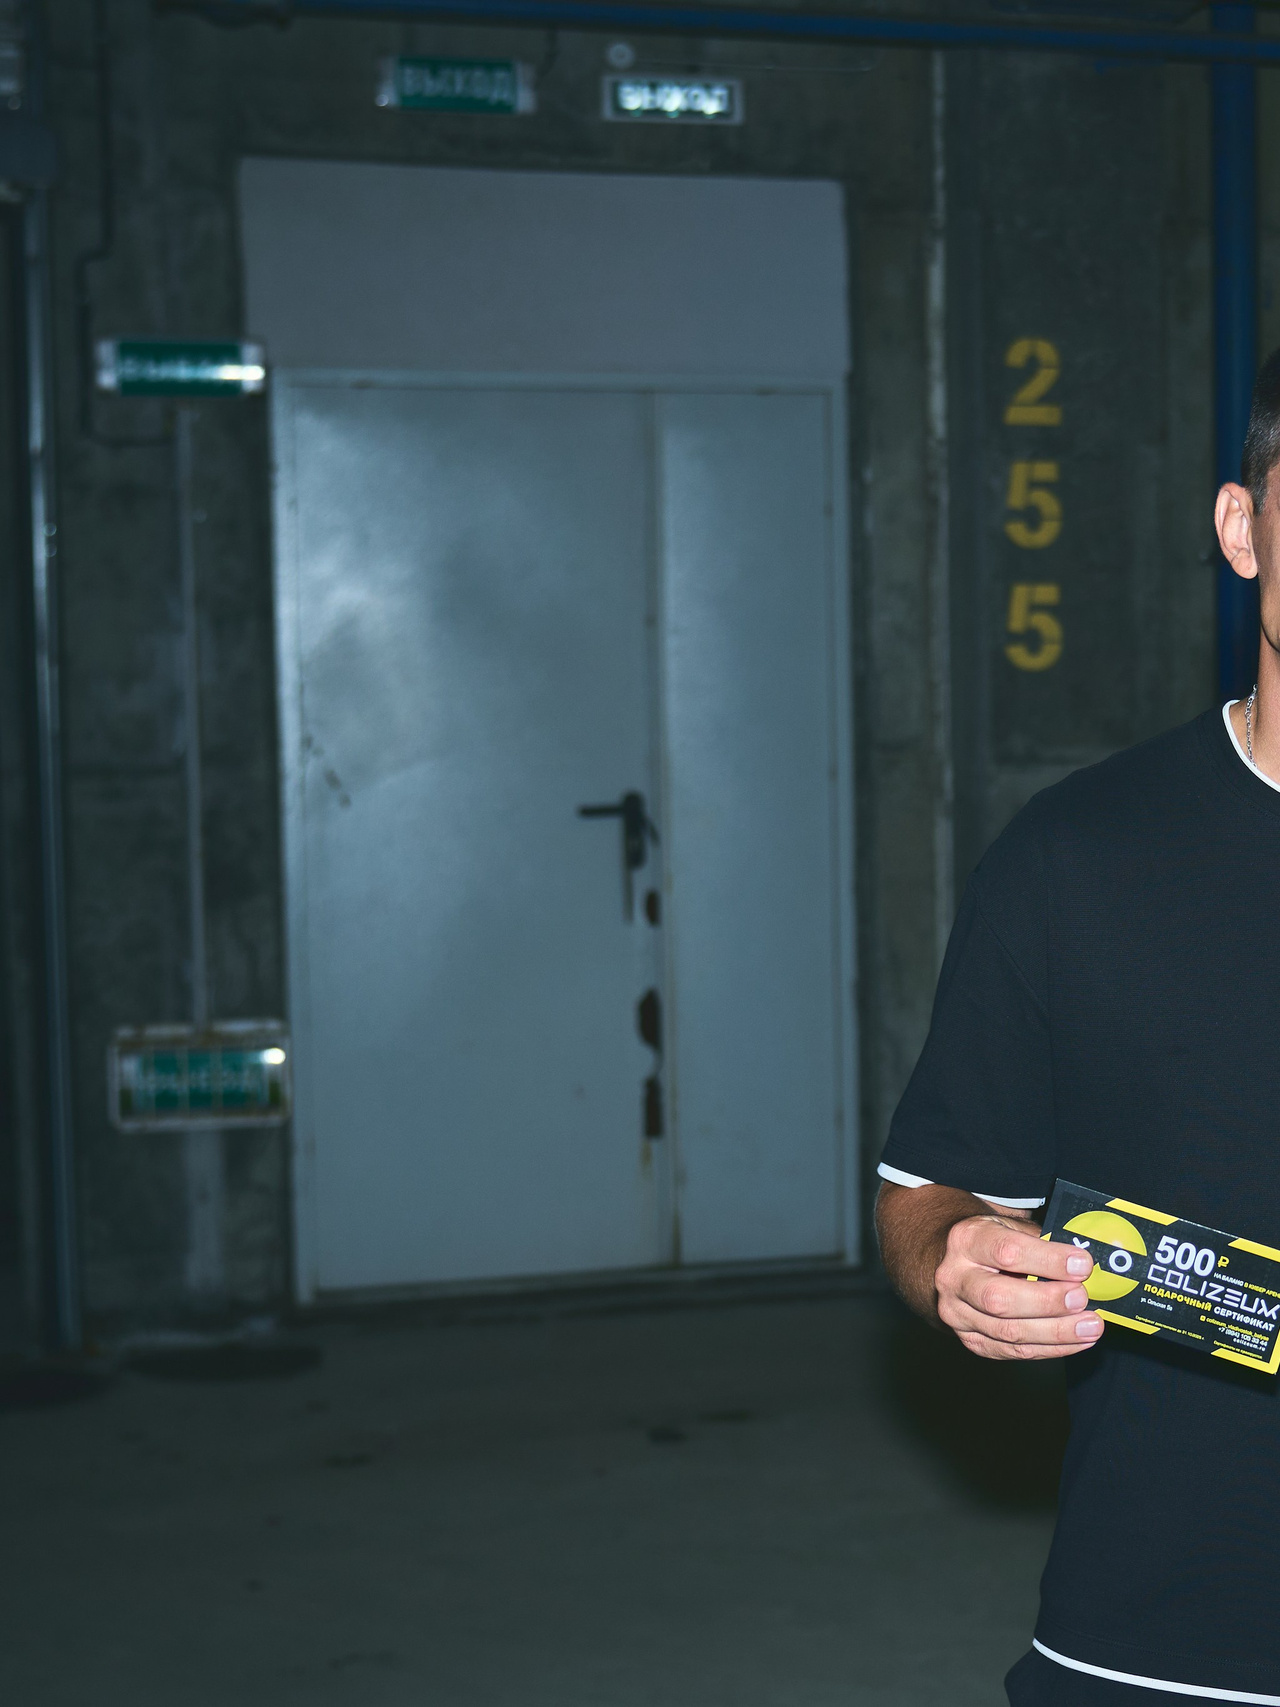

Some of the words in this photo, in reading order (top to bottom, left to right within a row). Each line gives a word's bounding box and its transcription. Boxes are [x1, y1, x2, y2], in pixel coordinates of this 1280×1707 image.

[404, 66, 511, 105] ВЫХОД
[1143, 1283, 1212, 1312] ПОДАРОЧНЫЙ
[1213, 1306, 1275, 1332] СЕРТИФИКАТ
[1147, 1264, 1280, 1320] COLIZEUM
